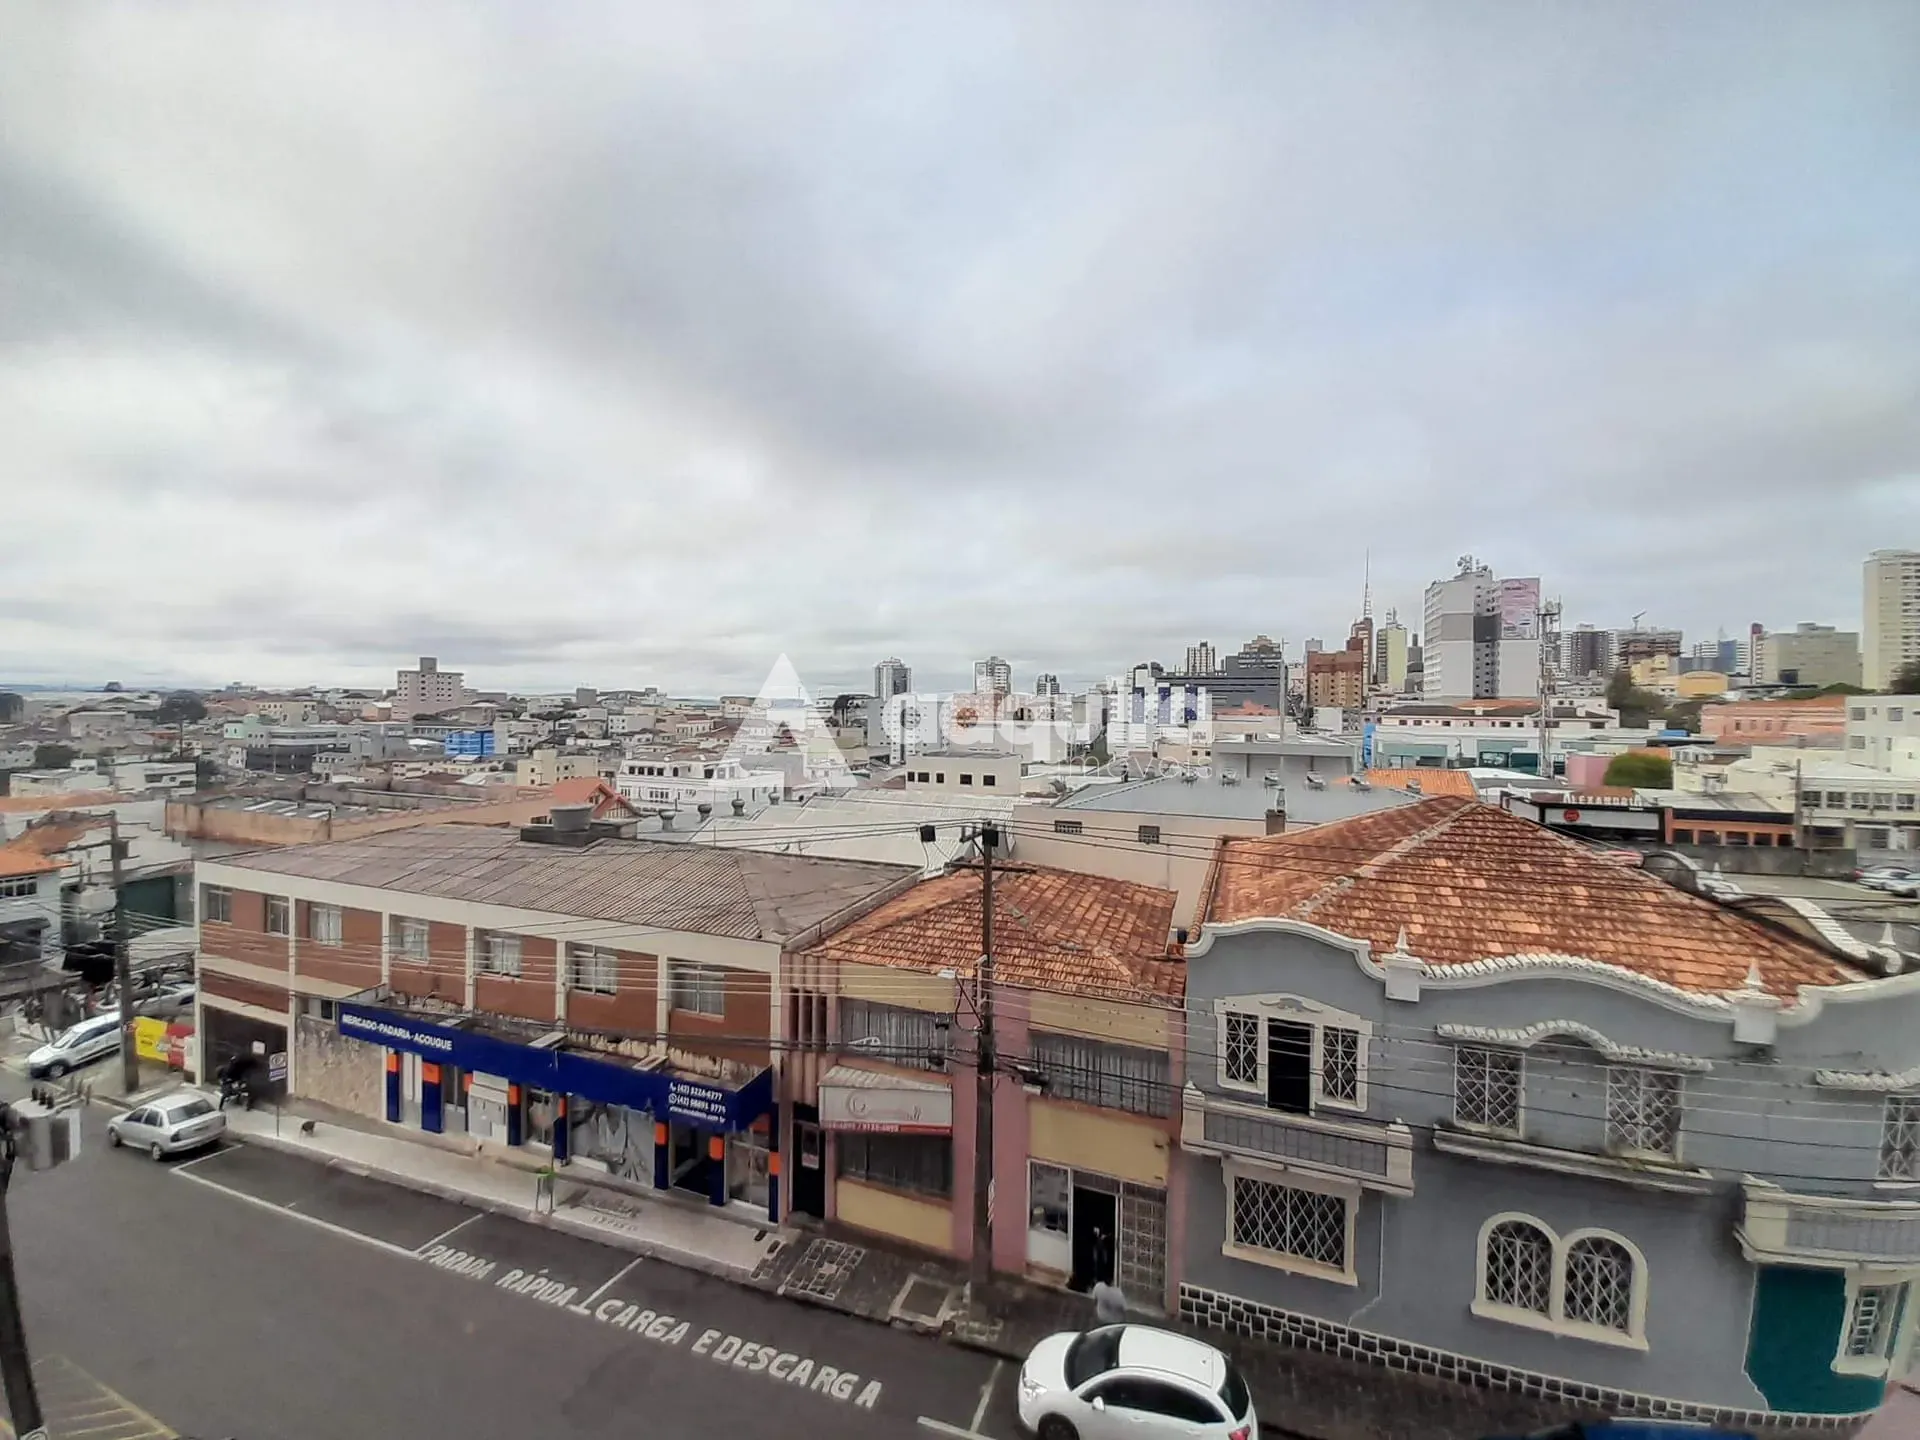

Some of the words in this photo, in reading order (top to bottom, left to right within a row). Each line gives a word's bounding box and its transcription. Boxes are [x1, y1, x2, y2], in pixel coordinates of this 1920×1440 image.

[342, 1013, 377, 1031] MERCADO
[379, 1023, 411, 1040] PADARIA
[429, 1244, 497, 1279] PARADA
[495, 1268, 578, 1307] RÁPIDA
[595, 1299, 690, 1344] CARGA
[692, 1329, 722, 1354] E
[712, 1336, 882, 1409] DESCARGA
